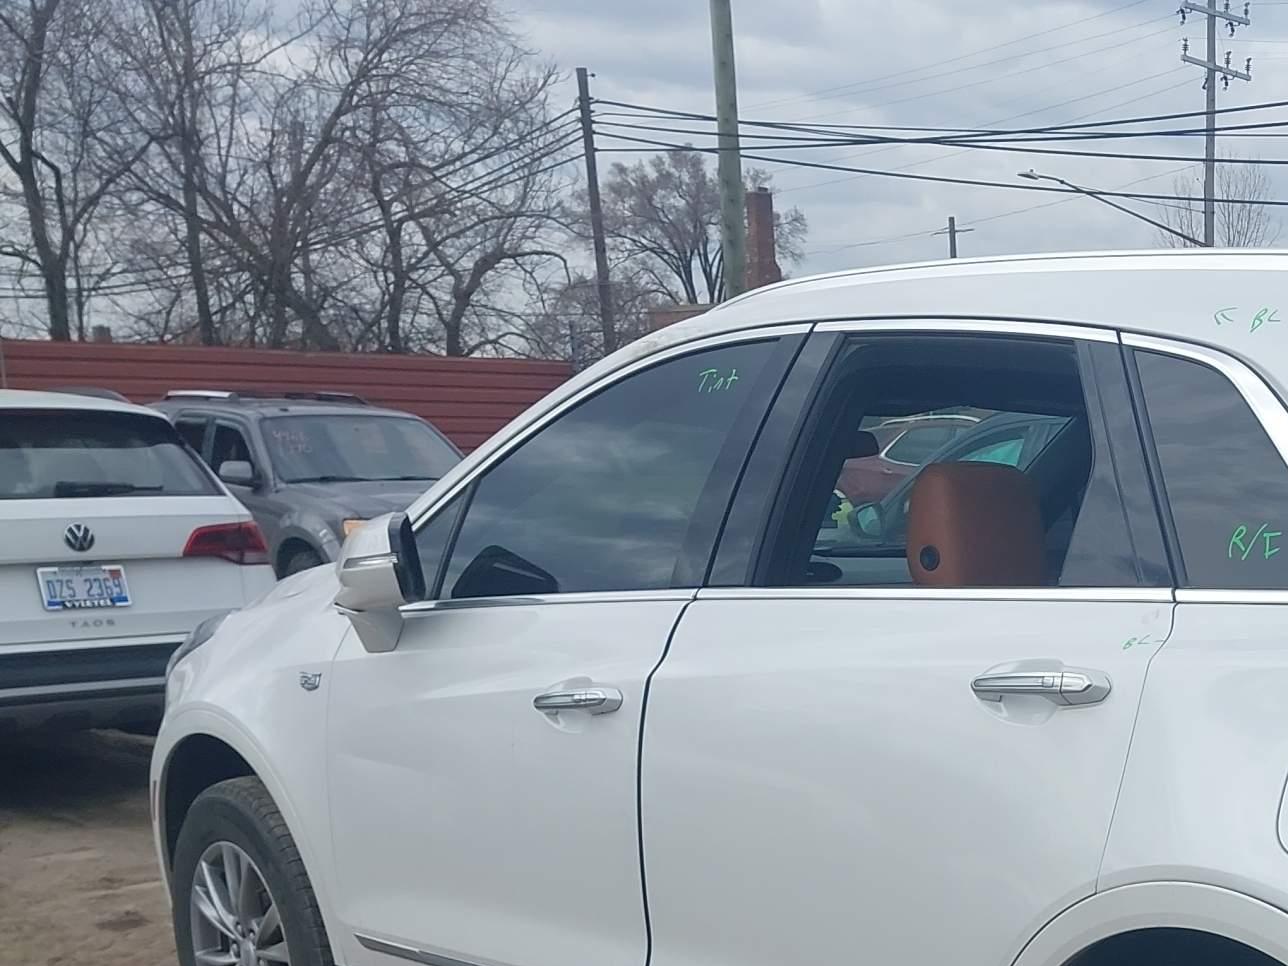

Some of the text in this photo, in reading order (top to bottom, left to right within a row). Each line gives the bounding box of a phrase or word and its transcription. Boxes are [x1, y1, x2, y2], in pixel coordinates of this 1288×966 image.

[698, 368, 739, 393] Tint
[84, 576, 123, 598] 2369
[71, 618, 116, 628] TAOS
